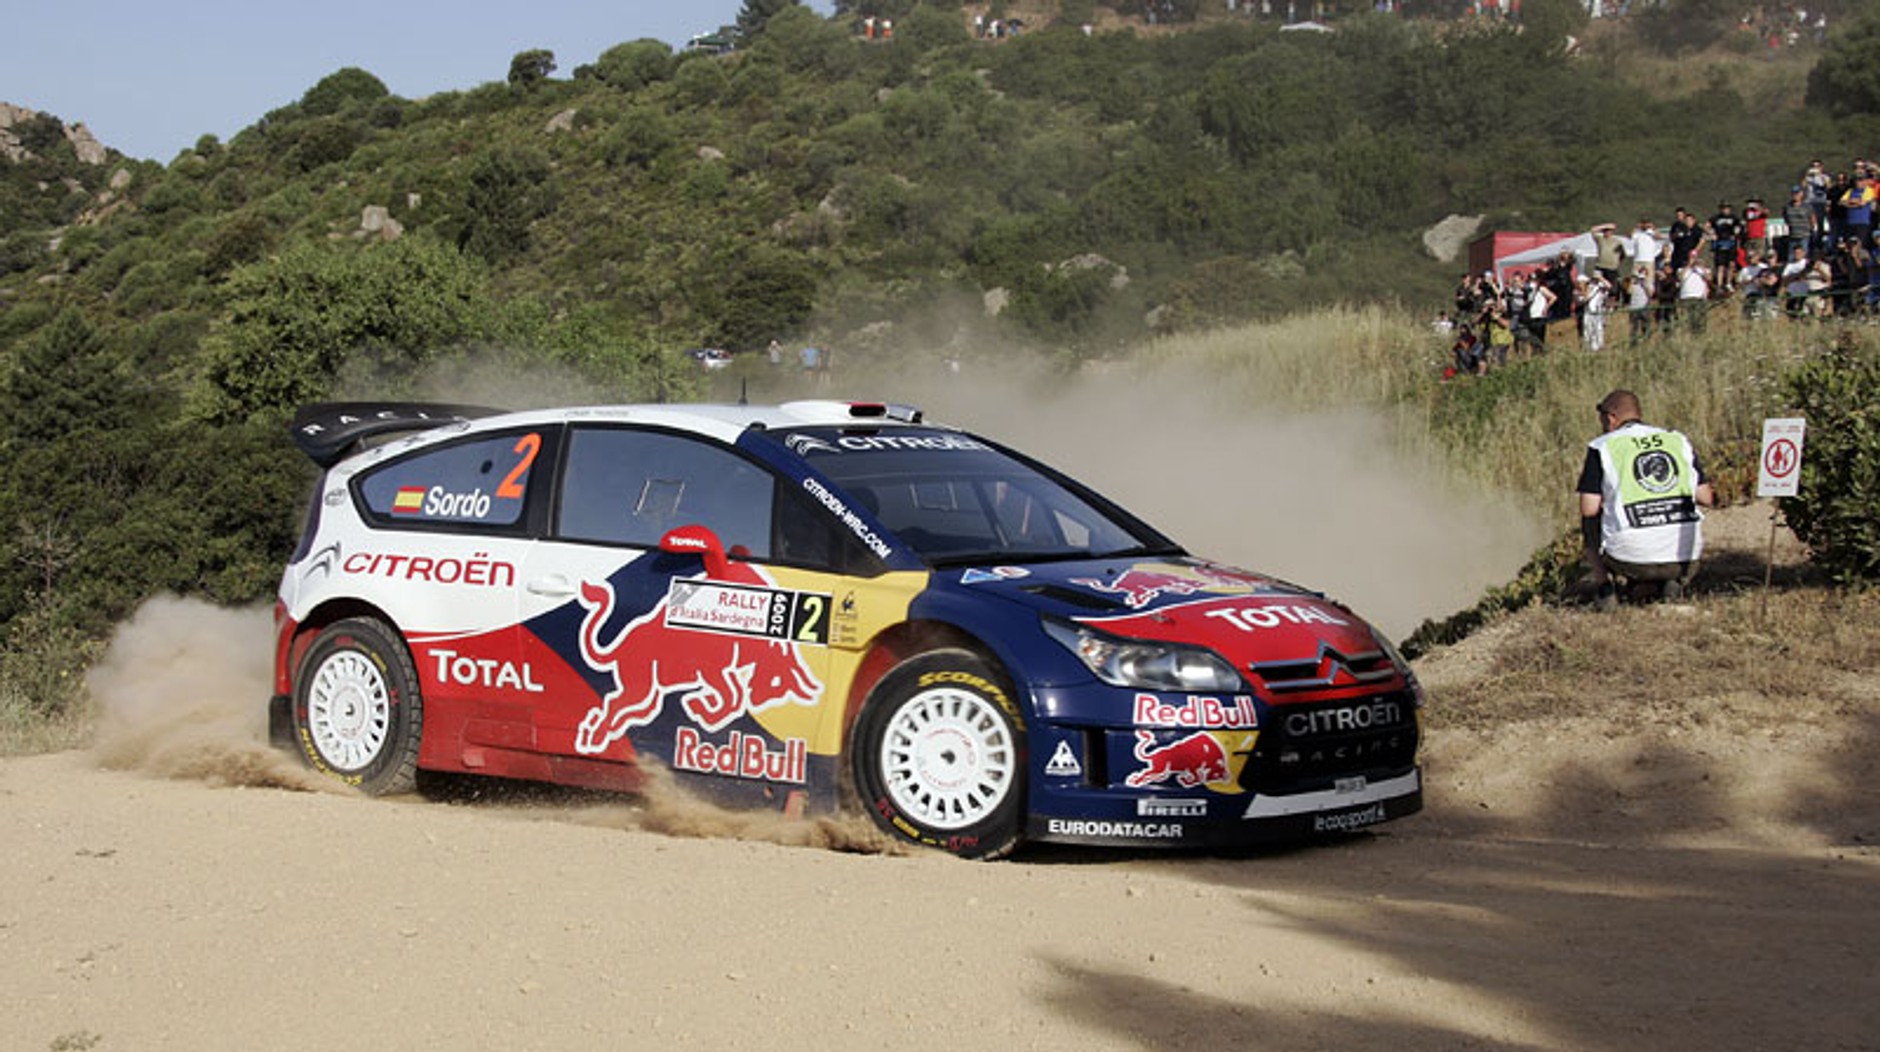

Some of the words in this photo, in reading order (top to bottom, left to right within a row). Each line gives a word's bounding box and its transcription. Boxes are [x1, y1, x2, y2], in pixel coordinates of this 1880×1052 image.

[1631, 434, 1663, 449] 155
[495, 432, 543, 499] 2
[425, 485, 491, 518] Sordo
[668, 535, 709, 549] TOTAL
[718, 591, 768, 611] RALLY
[769, 593, 790, 636] 2009
[709, 608, 766, 629] Sardegna
[797, 595, 825, 643] 2
[1204, 604, 1350, 632] TOTAL
[428, 649, 545, 692] TOTAL
[1133, 693, 1200, 727] Red
[1201, 696, 1258, 728] Bull
[674, 726, 740, 776] Red
[740, 734, 807, 783] Bull
[1137, 799, 1208, 816] PIRELLI
[1048, 819, 1183, 838] EURODATACAR
